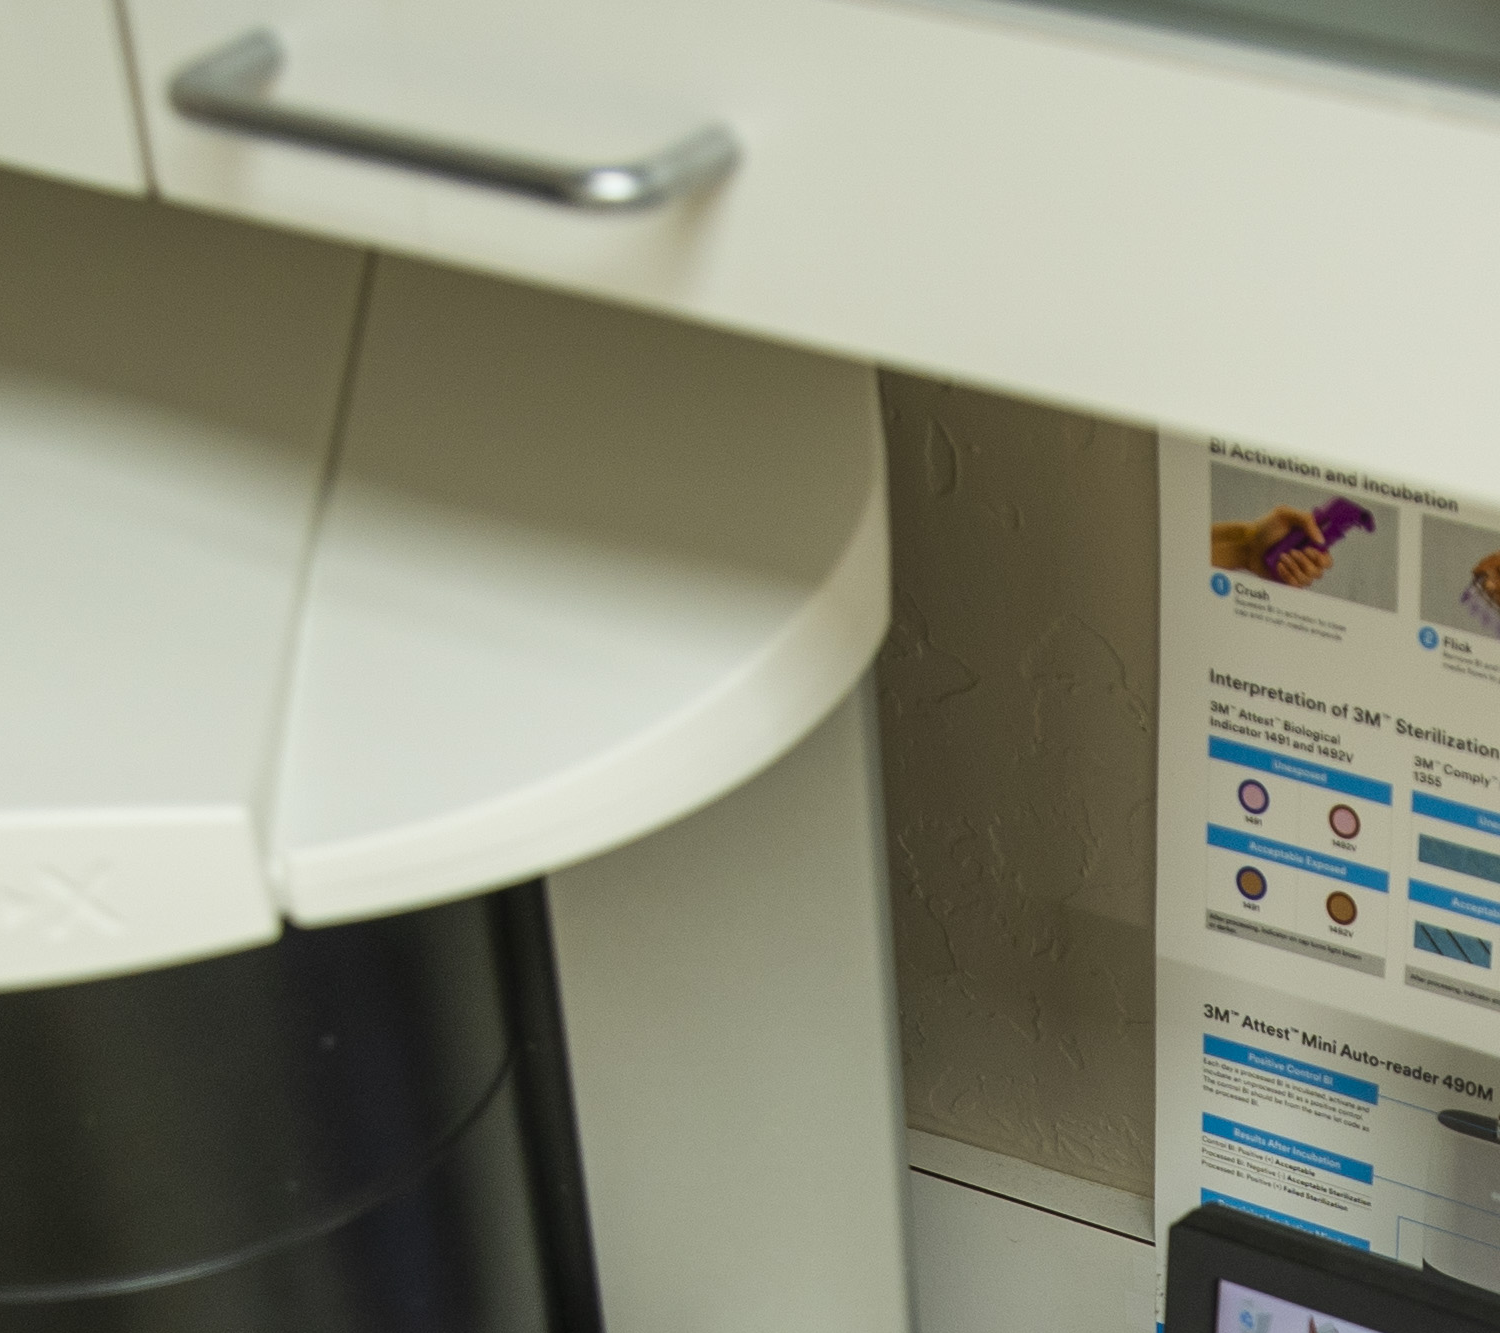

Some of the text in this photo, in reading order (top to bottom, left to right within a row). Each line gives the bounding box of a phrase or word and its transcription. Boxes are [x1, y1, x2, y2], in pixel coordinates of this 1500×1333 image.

[1326, 466, 1357, 488] and
[1235, 582, 1270, 601] Crush
[1444, 636, 1473, 654] Flick
[1209, 669, 1326, 715] Interpretation
[1332, 701, 1349, 719] of
[1395, 719, 1499, 760] Sterilization
[1210, 717, 1354, 763] Indicator 1491 and 1492V
[1284, 719, 1341, 745] Biological
[1302, 1032, 1336, 1055] Mini
[1340, 1044, 1439, 1085] Auto-reader
[1443, 1074, 1494, 1101] 490M
